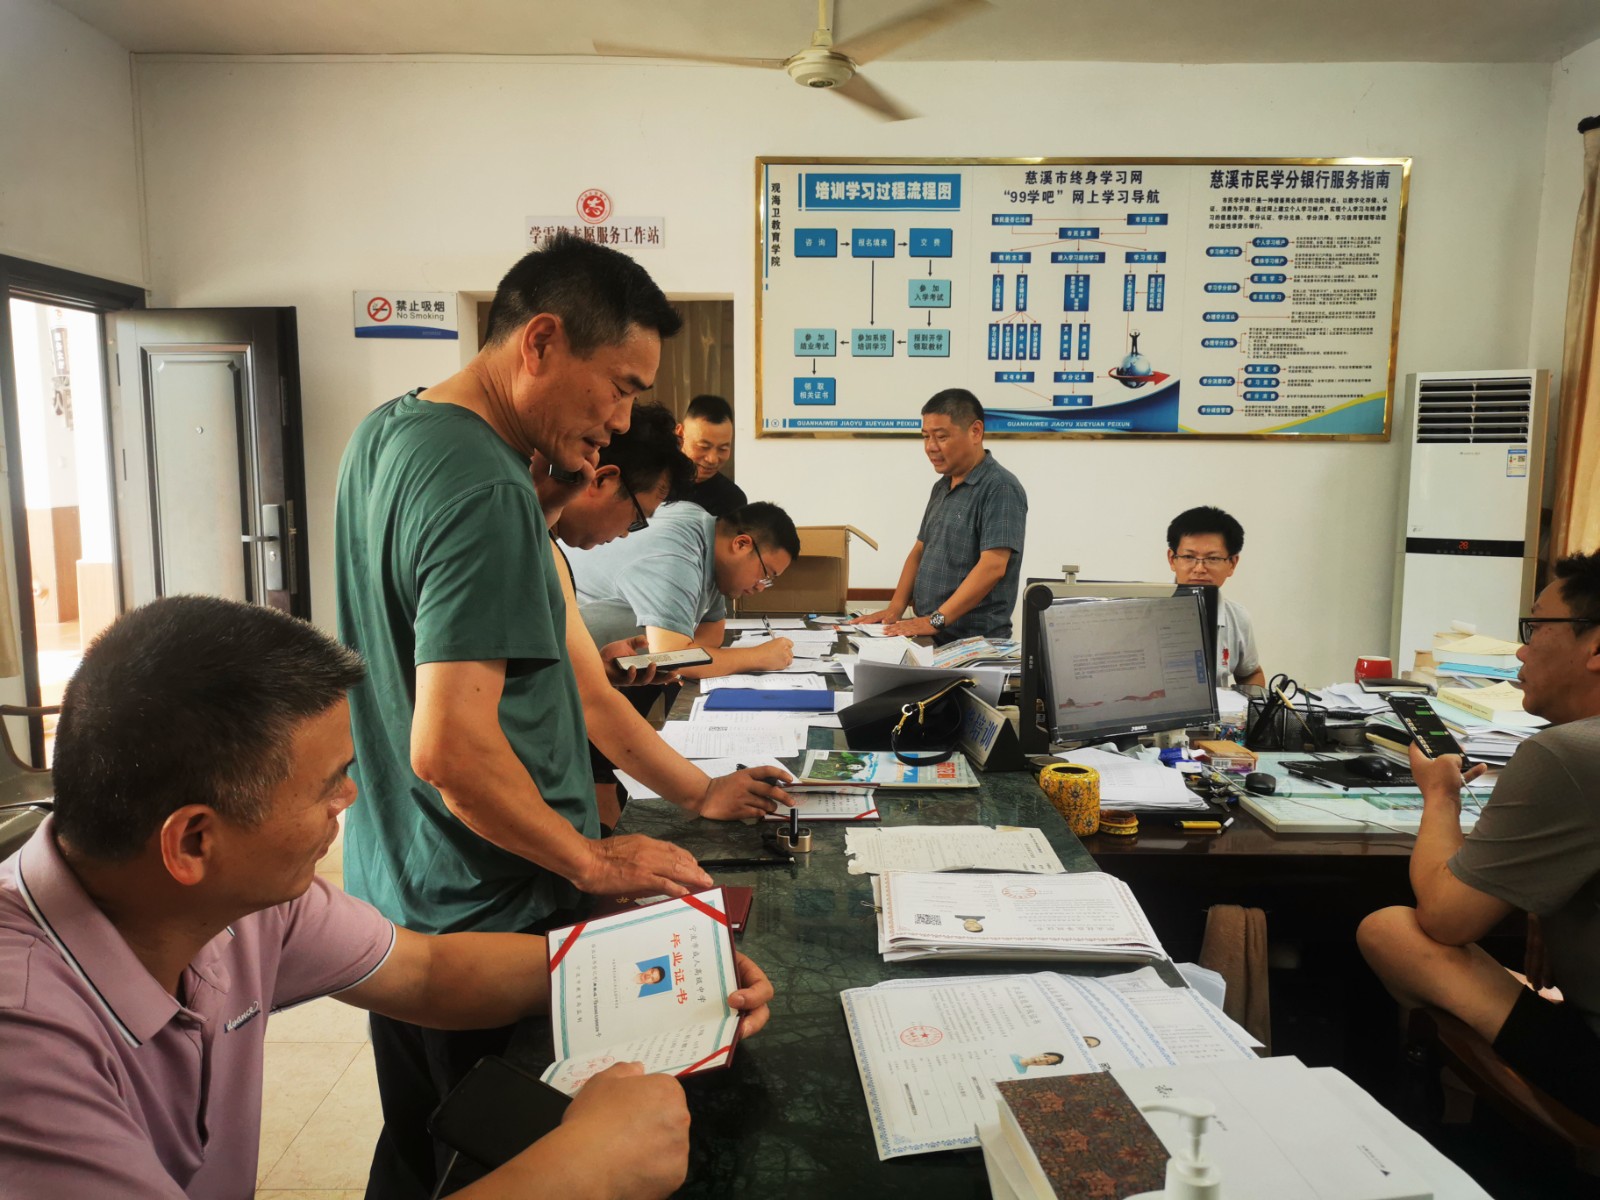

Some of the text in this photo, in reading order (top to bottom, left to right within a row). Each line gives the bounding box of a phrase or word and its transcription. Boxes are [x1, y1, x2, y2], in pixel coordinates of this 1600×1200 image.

[1025, 170, 1143, 185] 慈溪市终身学习网
[1210, 169, 1390, 189] 慈溪市民学分银行服务指南
[815, 181, 952, 200] 培训学习过程流程图
[771, 183, 781, 267] 观海卫教育学院
[805, 238, 826, 247] 咨询
[858, 238, 888, 247] 报名填表
[920, 238, 941, 247] 交费
[919, 284, 940, 292] 参加
[914, 293, 944, 301] 入学考试
[395, 300, 445, 312] 禁止吸烟
[396, 312, 444, 321] No Smoking
[805, 333, 825, 341] 参加
[857, 333, 887, 342] 参加系统
[914, 333, 943, 342] 报到开学
[800, 342, 830, 350] 结业考试
[857, 342, 887, 351] 培训学习
[913, 342, 943, 351] 领取教材
[804, 382, 825, 390] 领取
[800, 391, 829, 399] 相关证书
[670, 932, 688, 1005] 毕业证书
